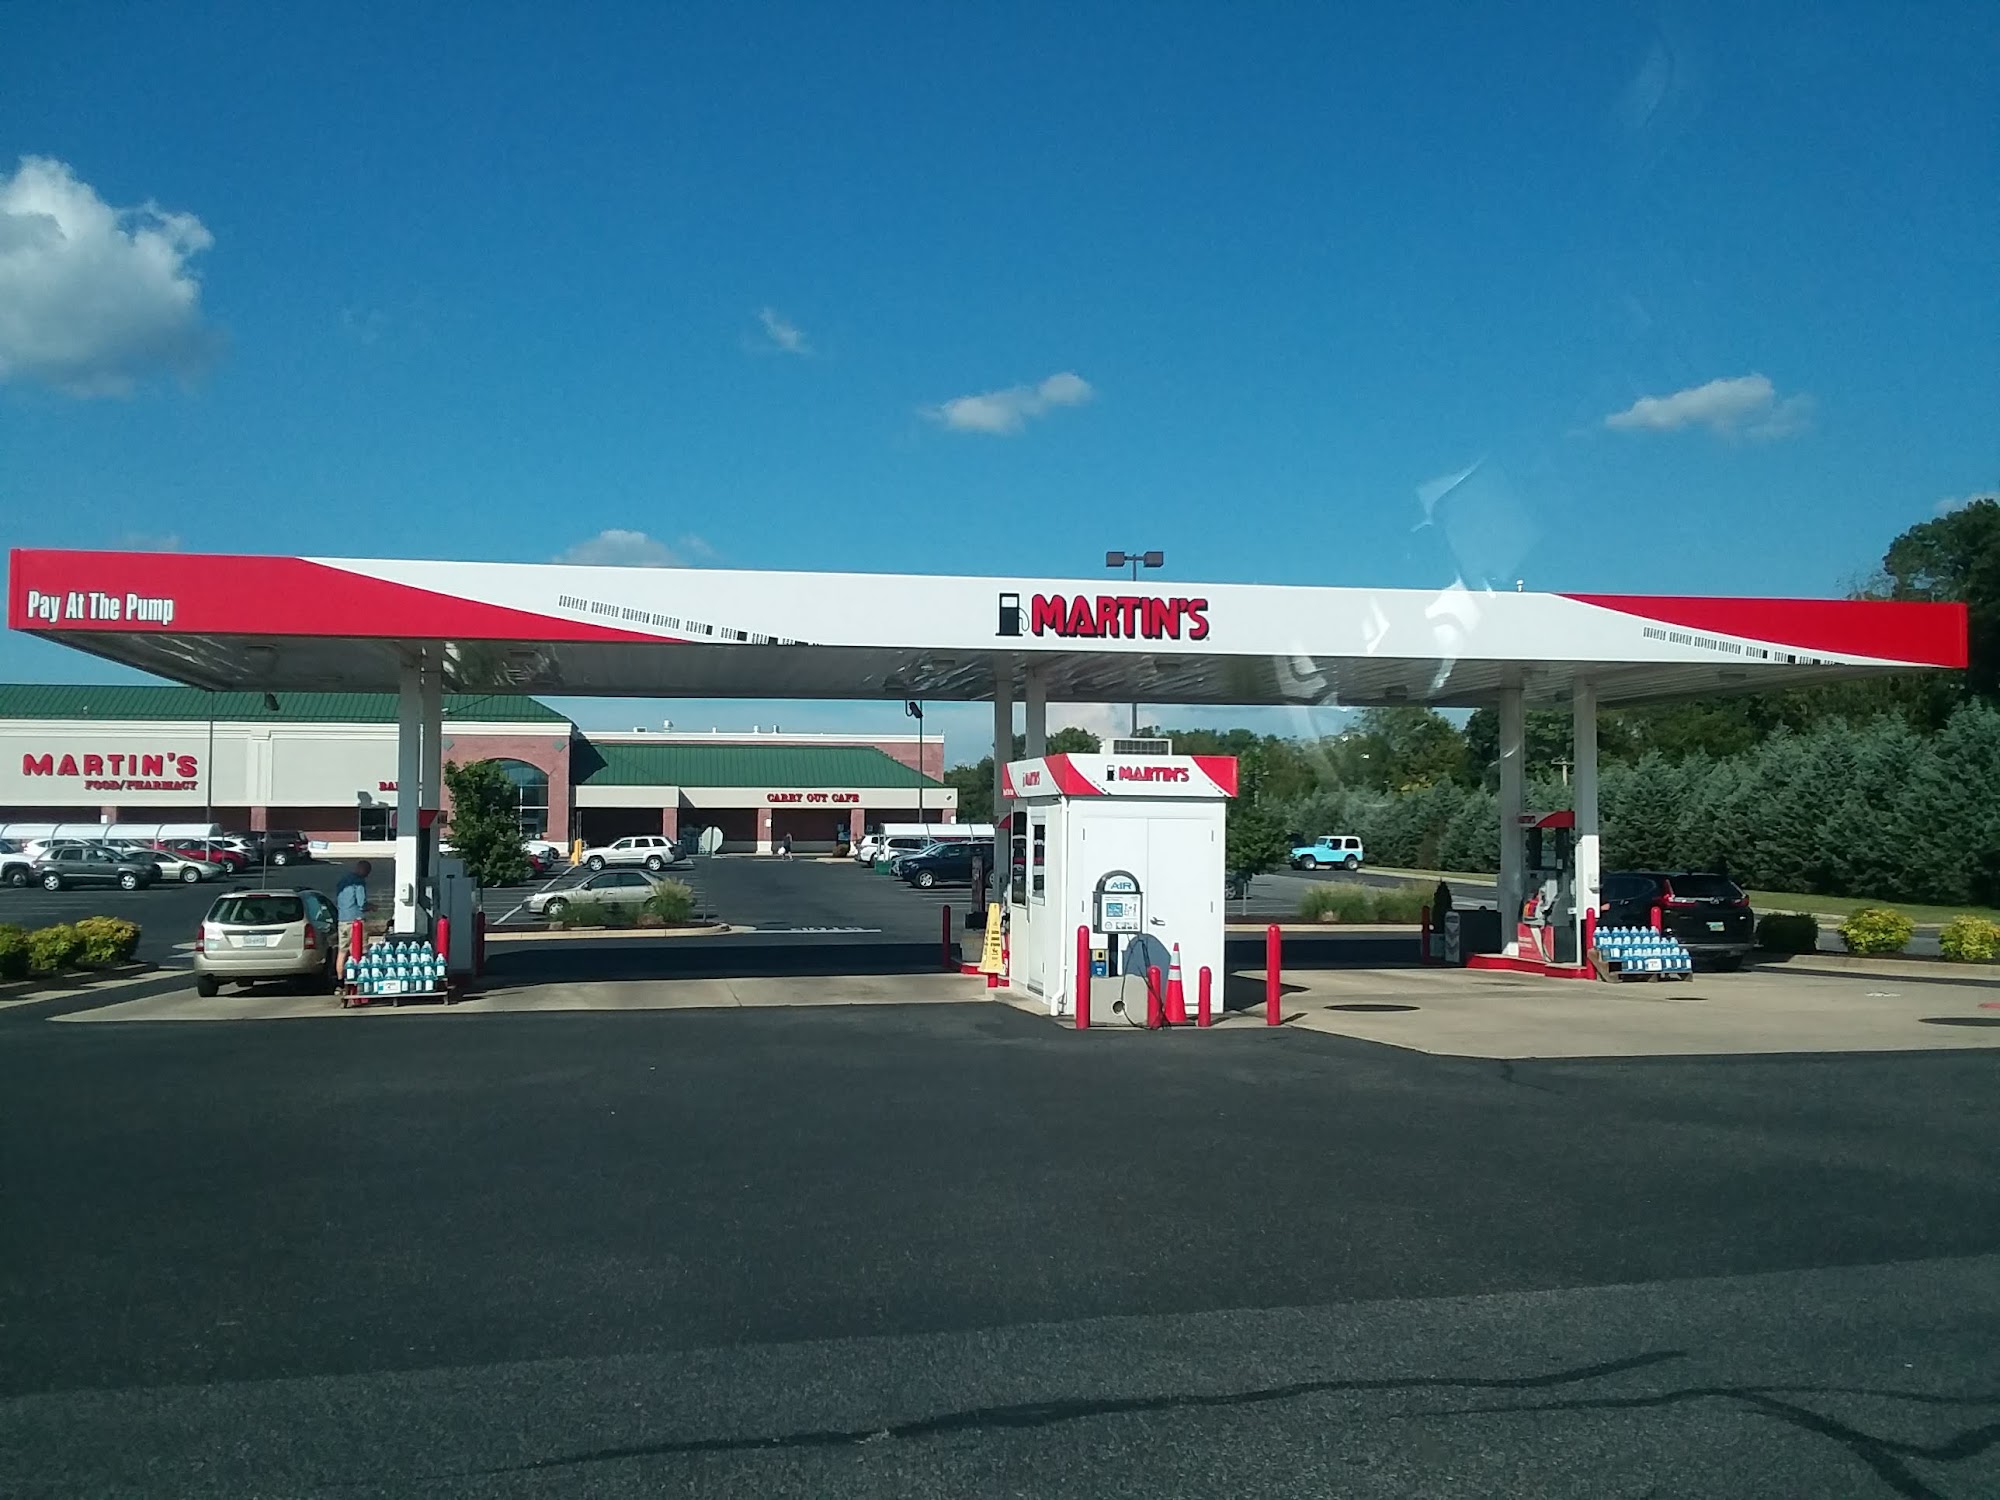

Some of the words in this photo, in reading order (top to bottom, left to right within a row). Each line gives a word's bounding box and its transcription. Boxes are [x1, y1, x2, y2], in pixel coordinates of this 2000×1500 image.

[27, 590, 61, 623] Pay
[65, 591, 85, 620] At
[88, 591, 121, 621] The
[125, 593, 175, 626] Pump
[1031, 593, 1210, 641] MARTIN'S
[23, 752, 198, 777] MARTIN'S
[1119, 766, 1190, 782] MARTIN'S
[84, 780, 198, 791] FOOD/PHARMACY
[767, 793, 803, 803] CARRY
[806, 793, 828, 803] OUT
[832, 793, 860, 803] CAFE
[1110, 882, 1133, 890] AIR
